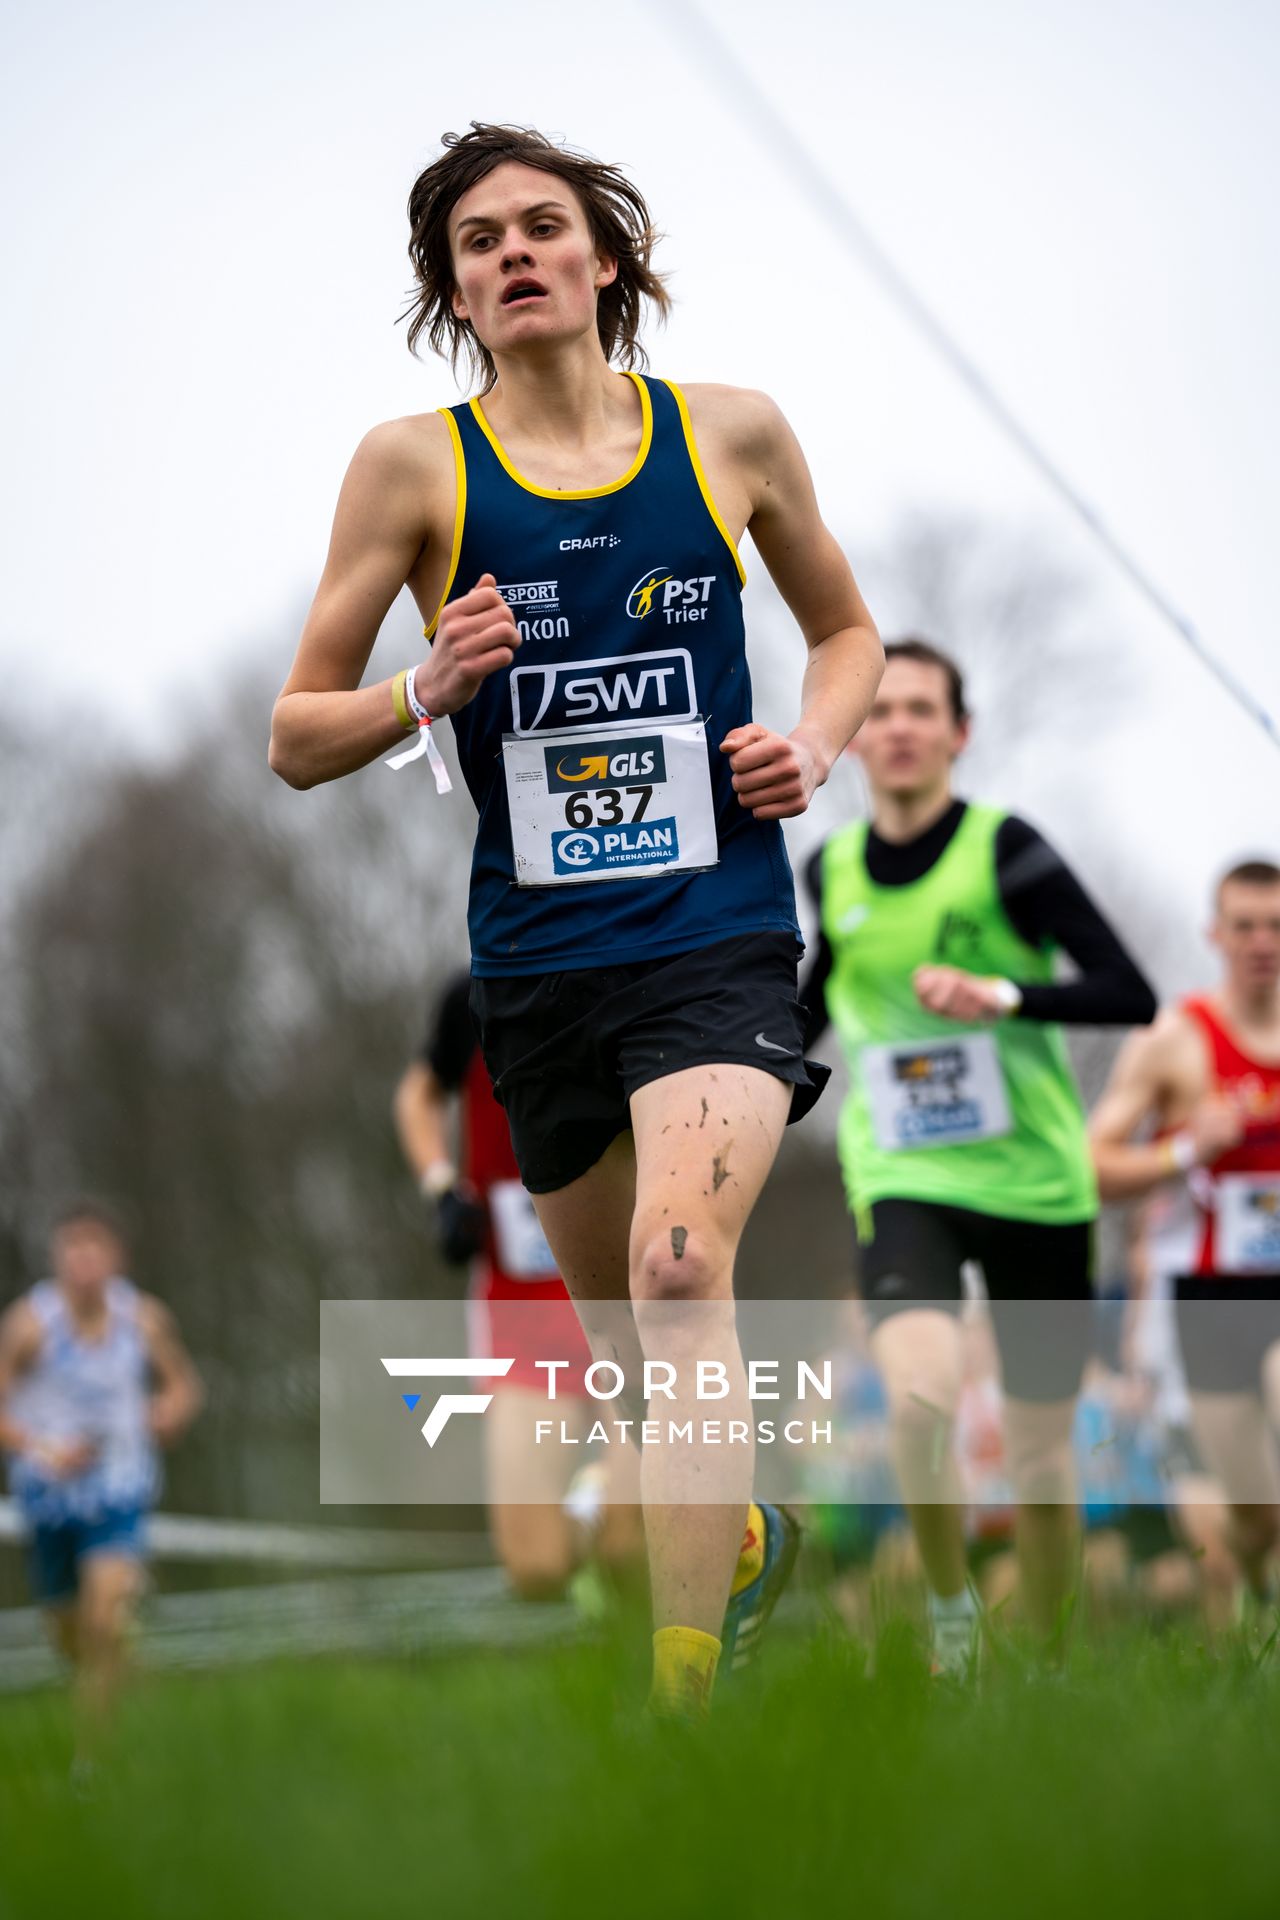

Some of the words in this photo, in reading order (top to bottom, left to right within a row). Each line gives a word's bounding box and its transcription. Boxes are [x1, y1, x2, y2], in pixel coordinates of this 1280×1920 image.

[559, 536, 608, 551] CRAFT
[663, 575, 716, 607] PST
[663, 606, 708, 625] Trier
[517, 617, 570, 641] nkon
[564, 667, 675, 718] SWT
[609, 750, 655, 778] GLS
[565, 785, 653, 829] 637
[604, 828, 672, 853] PLAN
[606, 850, 673, 862] INTERNATIONAL
